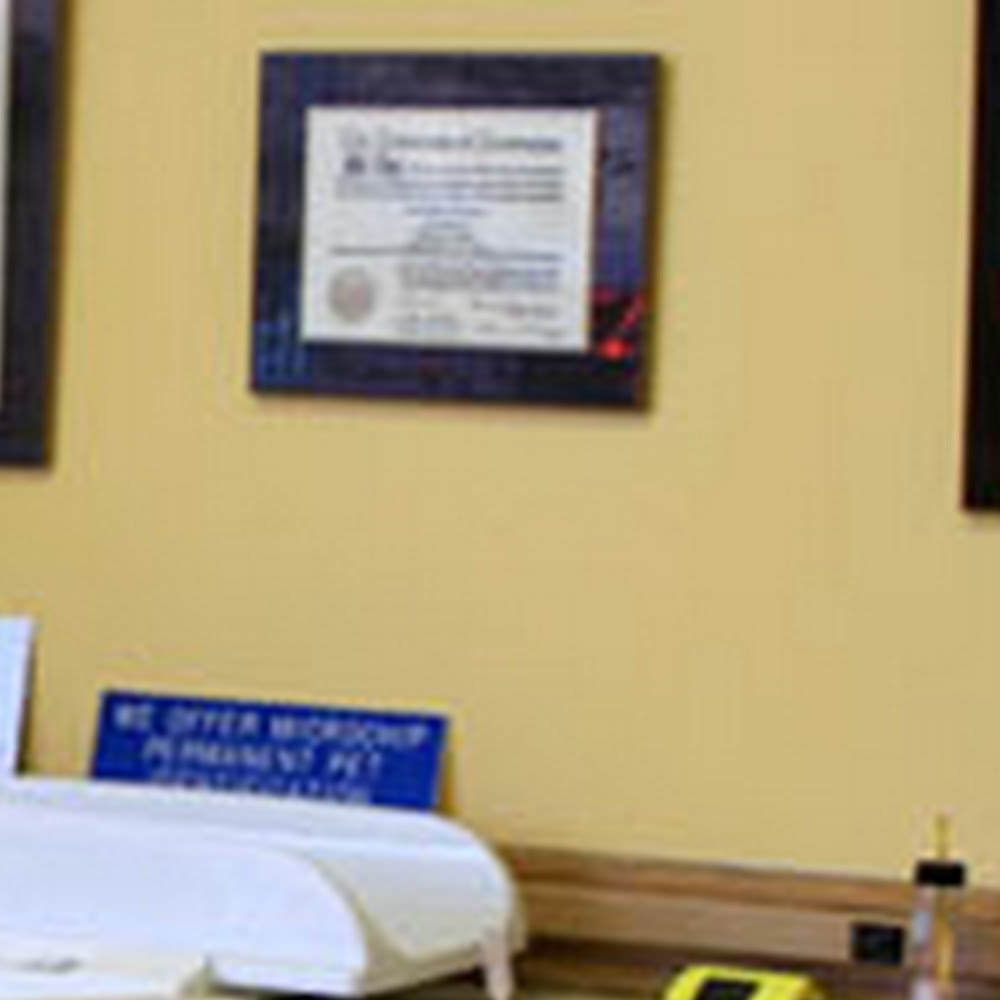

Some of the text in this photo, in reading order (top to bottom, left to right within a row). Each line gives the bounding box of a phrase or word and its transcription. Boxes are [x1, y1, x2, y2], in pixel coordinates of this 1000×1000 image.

[112, 702, 431, 750] WE OFFER MICROCHIP
[143, 737, 385, 782] PERMANENT PET
